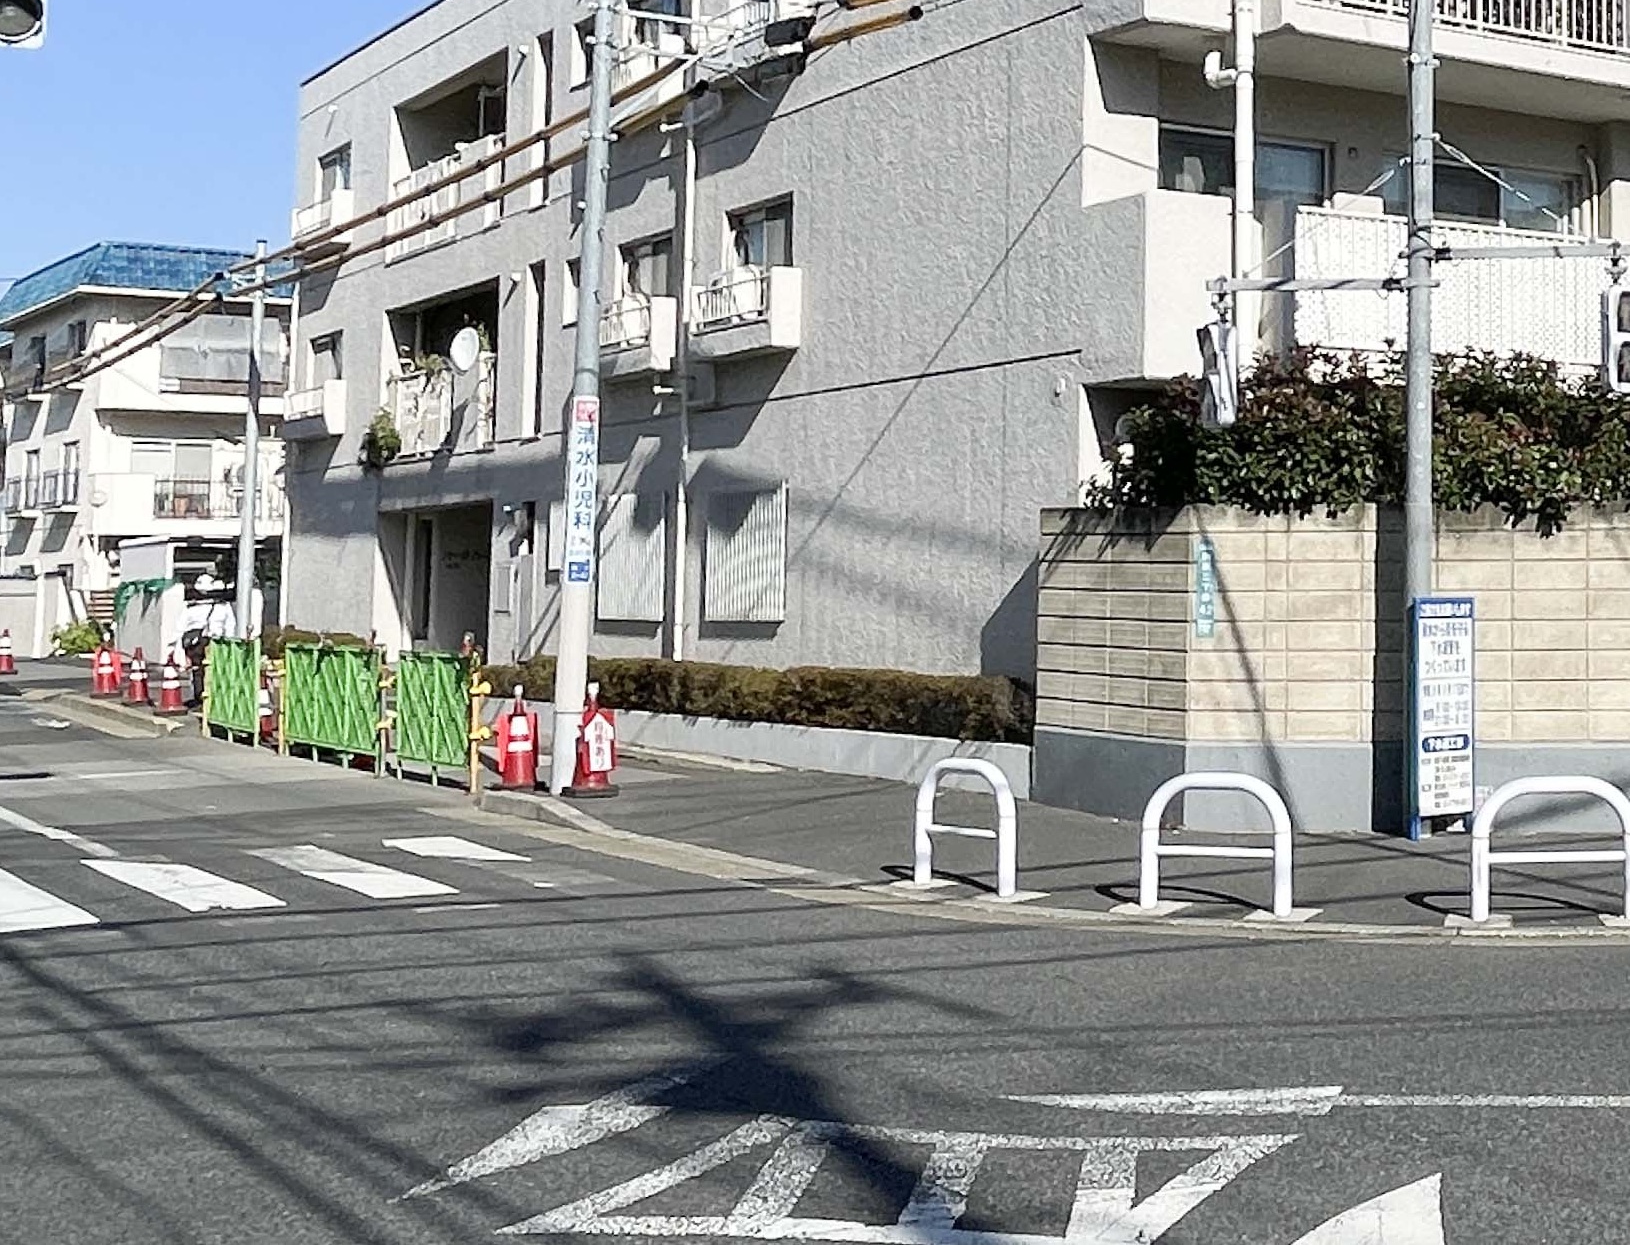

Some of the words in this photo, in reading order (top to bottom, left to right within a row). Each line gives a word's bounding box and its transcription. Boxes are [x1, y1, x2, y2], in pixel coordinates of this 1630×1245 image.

[573, 425, 596, 530] 清水小児科
